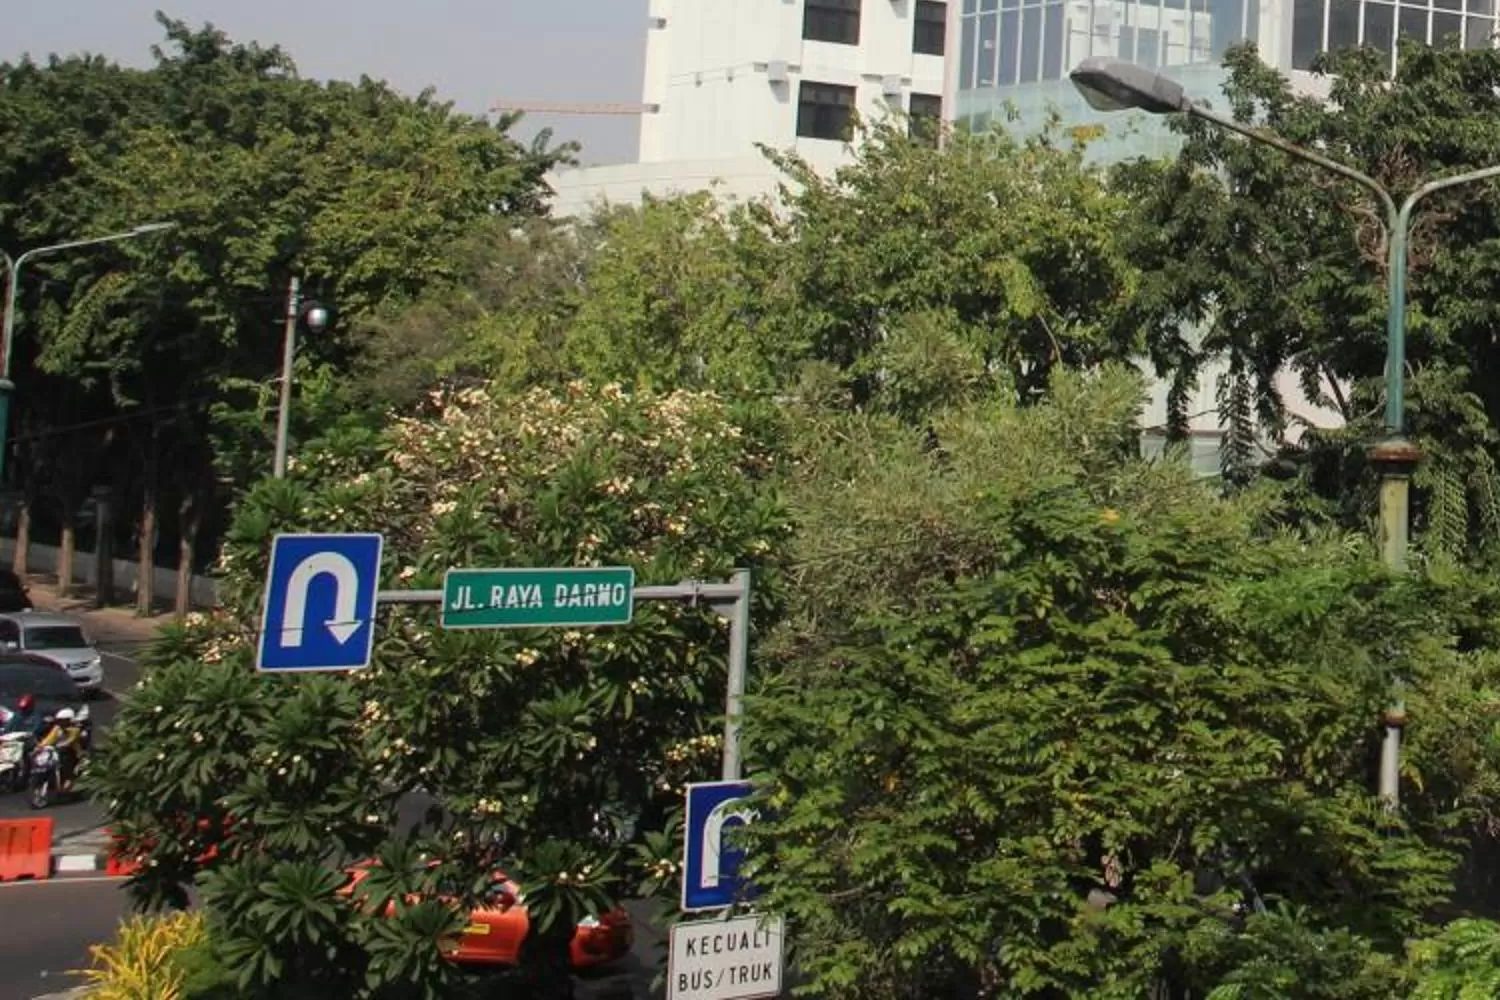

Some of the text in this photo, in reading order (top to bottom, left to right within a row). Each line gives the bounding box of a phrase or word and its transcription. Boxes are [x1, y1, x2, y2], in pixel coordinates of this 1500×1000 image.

[451, 582, 626, 611] JL. RAYA DARMO
[685, 929, 771, 958] KECUALI
[678, 961, 773, 992] BUS/TRUK
